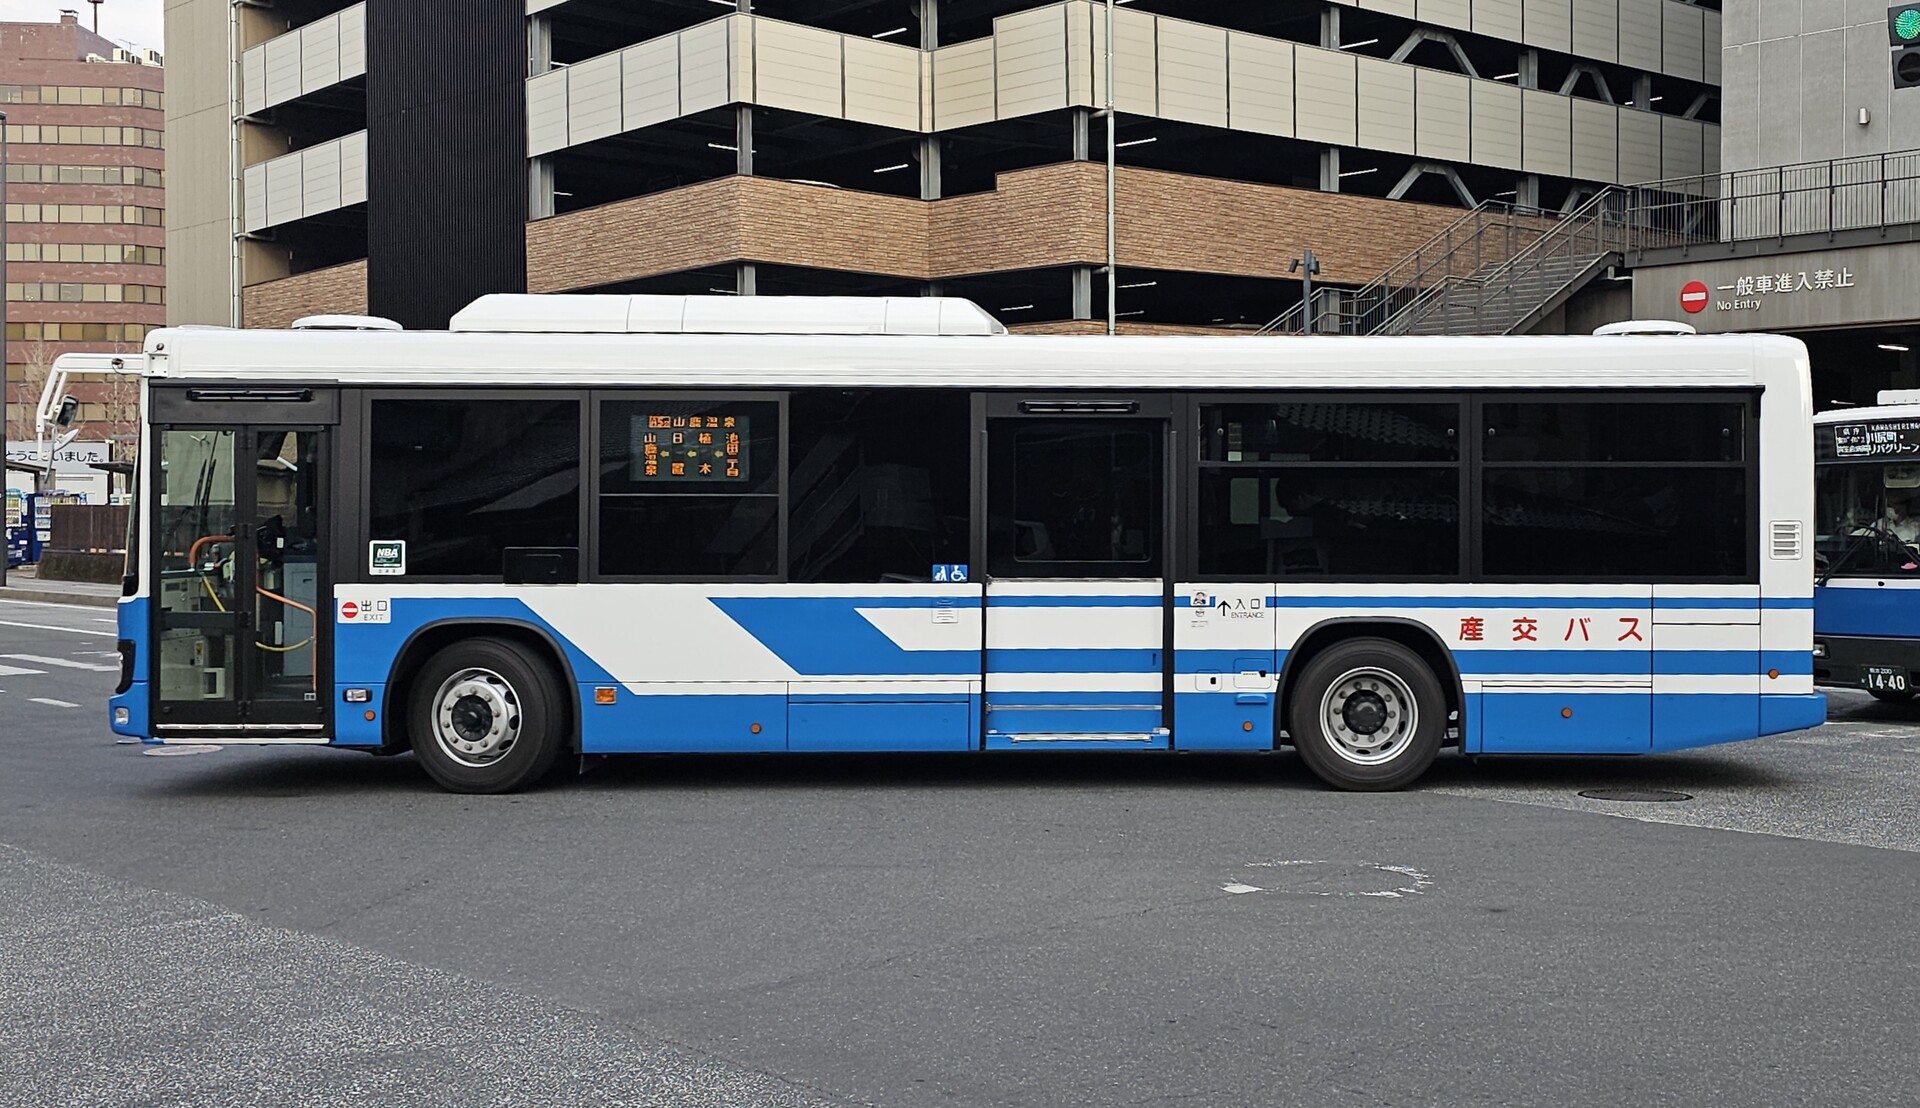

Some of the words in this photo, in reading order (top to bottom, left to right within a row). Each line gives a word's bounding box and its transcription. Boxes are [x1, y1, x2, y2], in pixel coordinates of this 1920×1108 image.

[1717, 267, 1854, 296] 一般車進入禁止
[1717, 301, 1731, 310] No
[1735, 299, 1761, 311] Entry
[376, 548, 399, 559] NBA
[360, 600, 388, 612] 出口
[1235, 598, 1260, 610] 入口
[363, 613, 384, 621] EXIT
[1230, 611, 1265, 619] ENTRANCE
[1459, 616, 1643, 642] 産交バス
